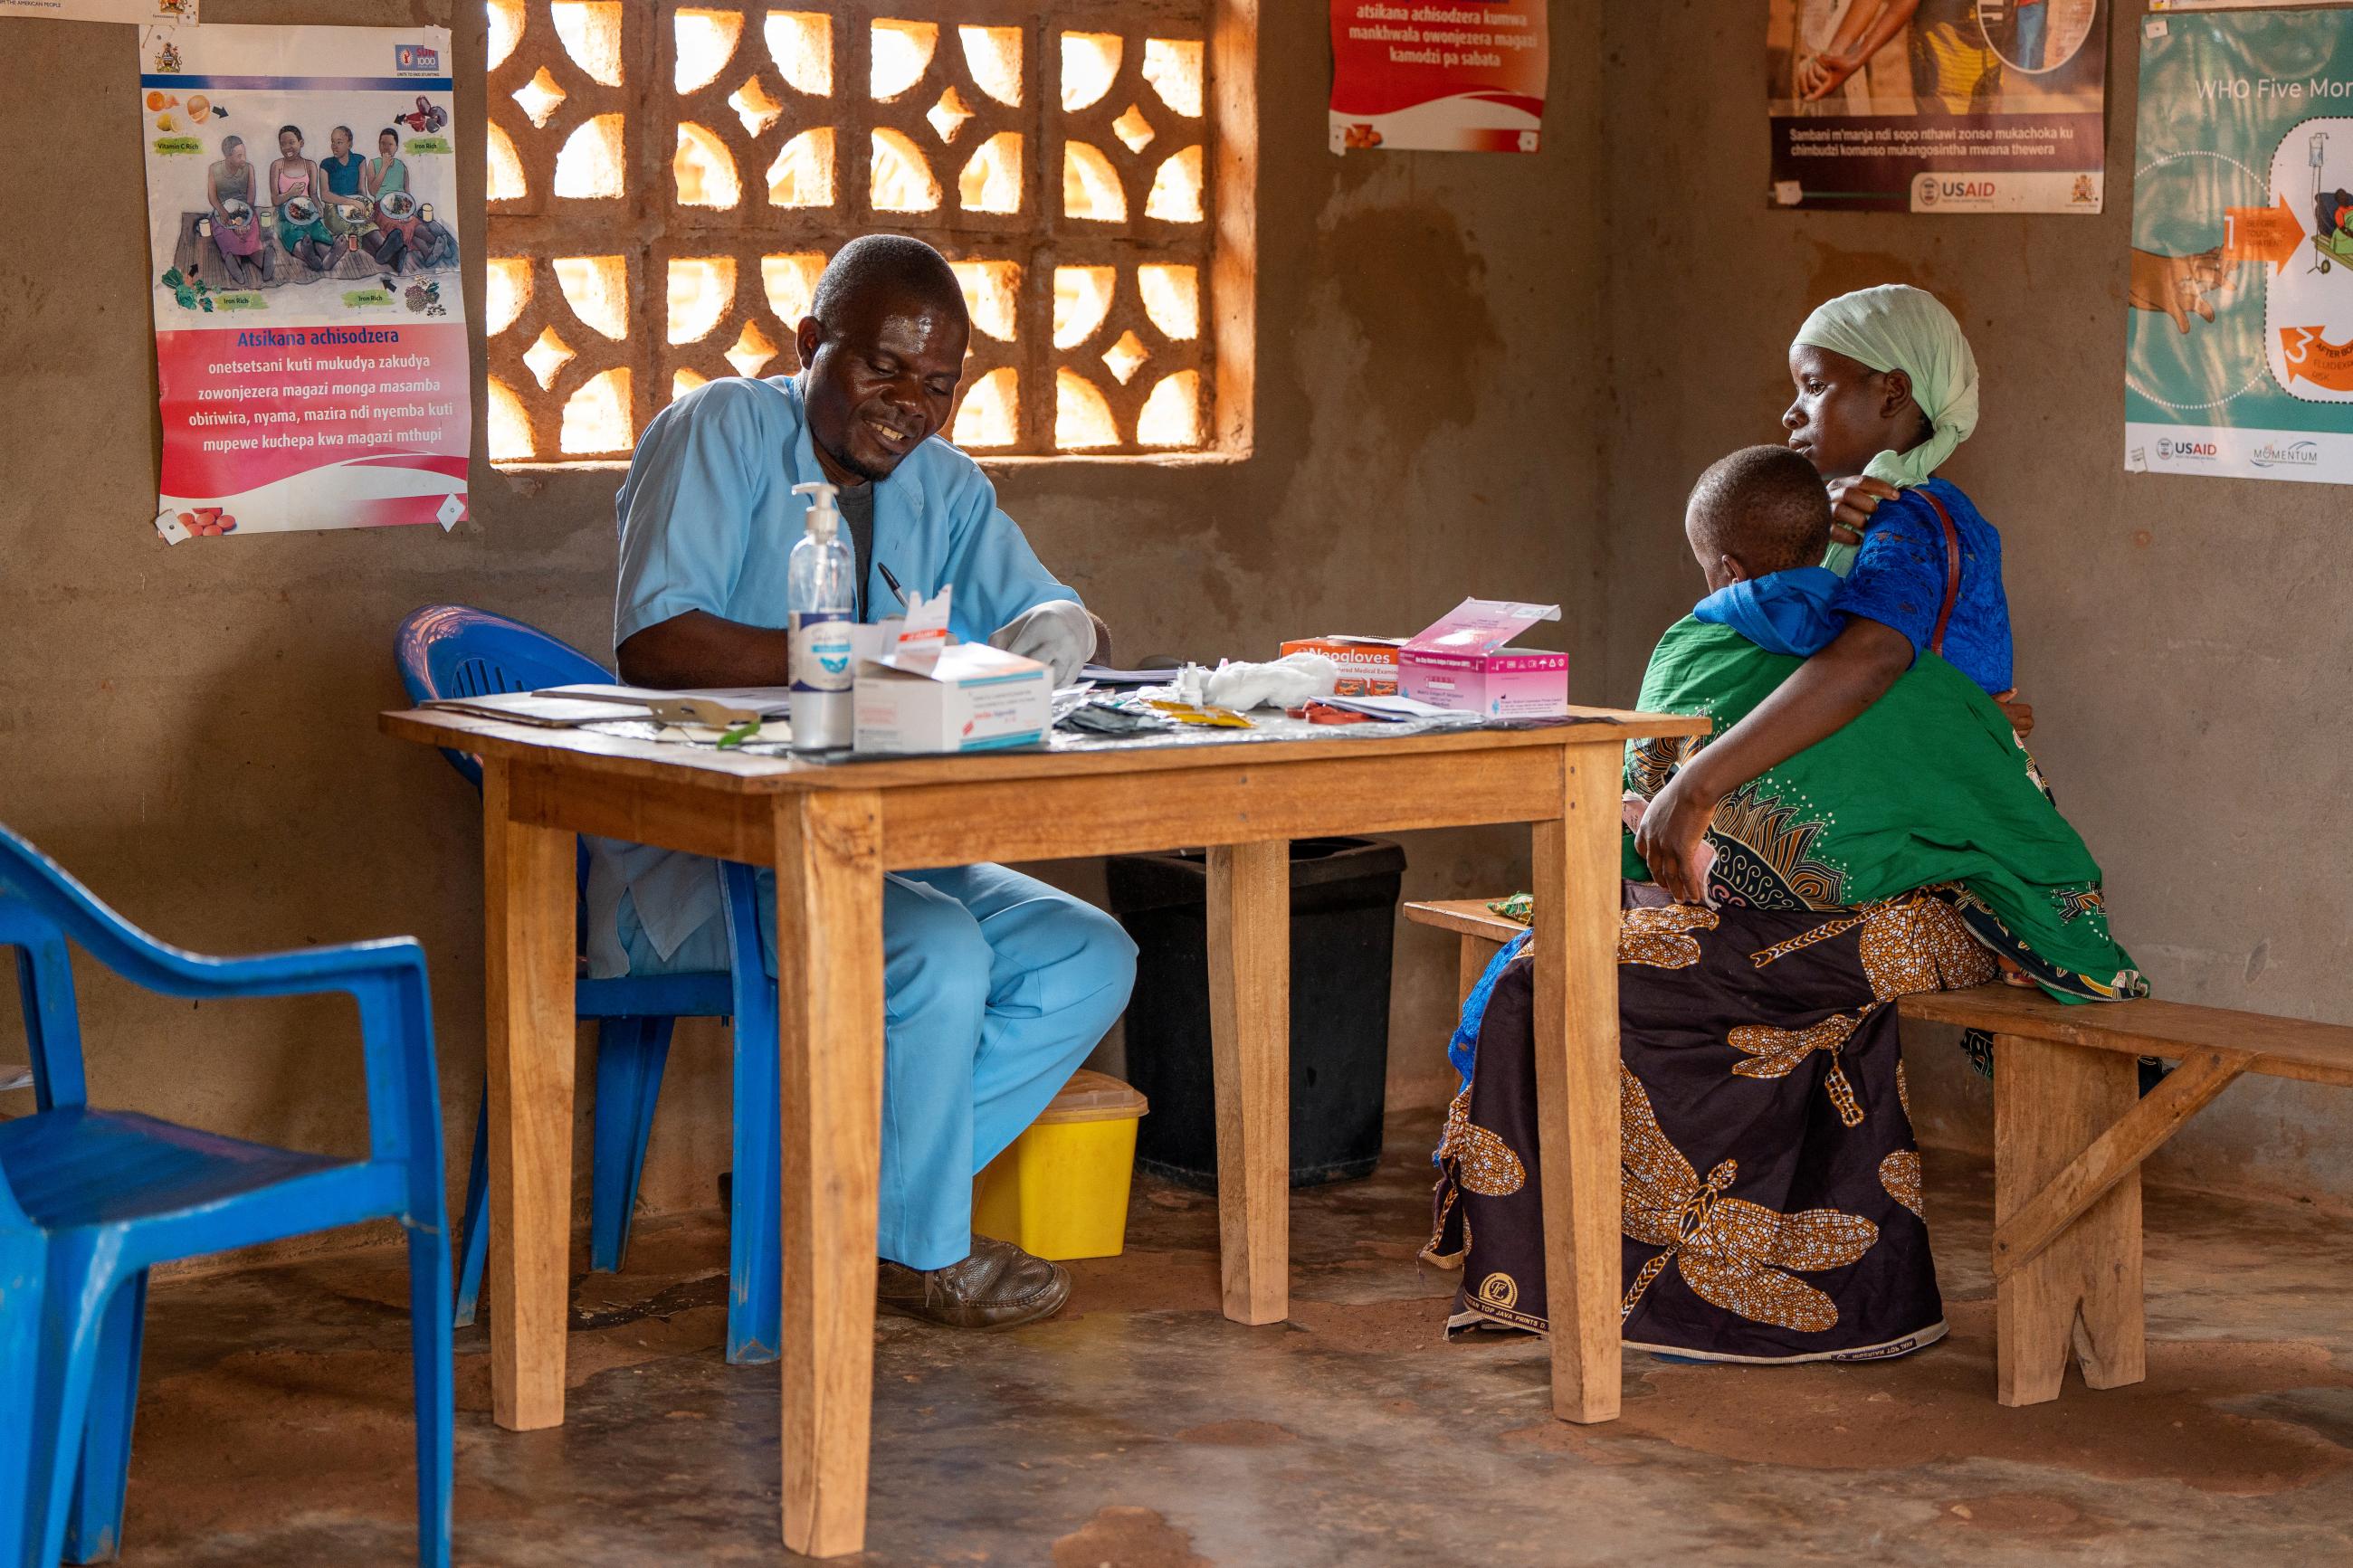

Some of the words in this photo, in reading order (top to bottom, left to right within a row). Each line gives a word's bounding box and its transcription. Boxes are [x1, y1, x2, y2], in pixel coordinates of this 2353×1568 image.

[1357, 5, 1408, 21] atsikana
[1411, 6, 1481, 24] achisodzera
[1483, 10, 1527, 26] kumwa
[1348, 25, 1420, 43] mankhwala
[1423, 29, 1491, 47] owonjezera
[416, 48, 435, 57] SUN
[1389, 46, 1441, 63] kamodzi
[1443, 52, 1459, 67] pa
[1462, 52, 1500, 67] sabata
[2196, 80, 2250, 100] WHO
[2258, 77, 2301, 98] Five
[1875, 128, 1891, 140] ndi
[1893, 130, 1919, 143] sopo
[1920, 128, 1956, 140] nthawi
[1996, 127, 2057, 139] mukachoka
[2060, 127, 2073, 139] ku
[1887, 143, 1967, 158] mukangosintha
[1969, 146, 2009, 156] mwana
[2011, 144, 2055, 156] thewera
[1942, 182, 1995, 196] USAID
[237, 328, 306, 347] Atsikana
[310, 328, 399, 345] achisodzera
[2285, 327, 2314, 364] 3
[208, 360, 282, 375] onetsetsani
[286, 357, 312, 372] kuti
[316, 356, 376, 373] mukudya
[378, 355, 430, 371] zakudya
[198, 385, 279, 404] zowonjezera
[282, 384, 329, 400] magazi
[332, 382, 376, 397] monga
[379, 379, 441, 394] masamba
[188, 411, 251, 428] obiriwira,
[254, 412, 300, 425] nyama,
[304, 406, 347, 422] mazira
[350, 404, 369, 419] ndi
[373, 404, 424, 420] nyemba
[428, 402, 453, 416] kuti
[203, 437, 259, 451] mupewe
[262, 432, 315, 450] kuchepa
[318, 432, 344, 446] kwa
[347, 431, 393, 446] magazi
[396, 428, 442, 443] mthupi
[2176, 442, 2216, 456] USAID
[2253, 450, 2317, 461] MOMENTUM
[1481, 1305, 1494, 1314] TOP
[1496, 1309, 1512, 1320] JAVA
[1515, 1315, 1538, 1326] PRINTS
